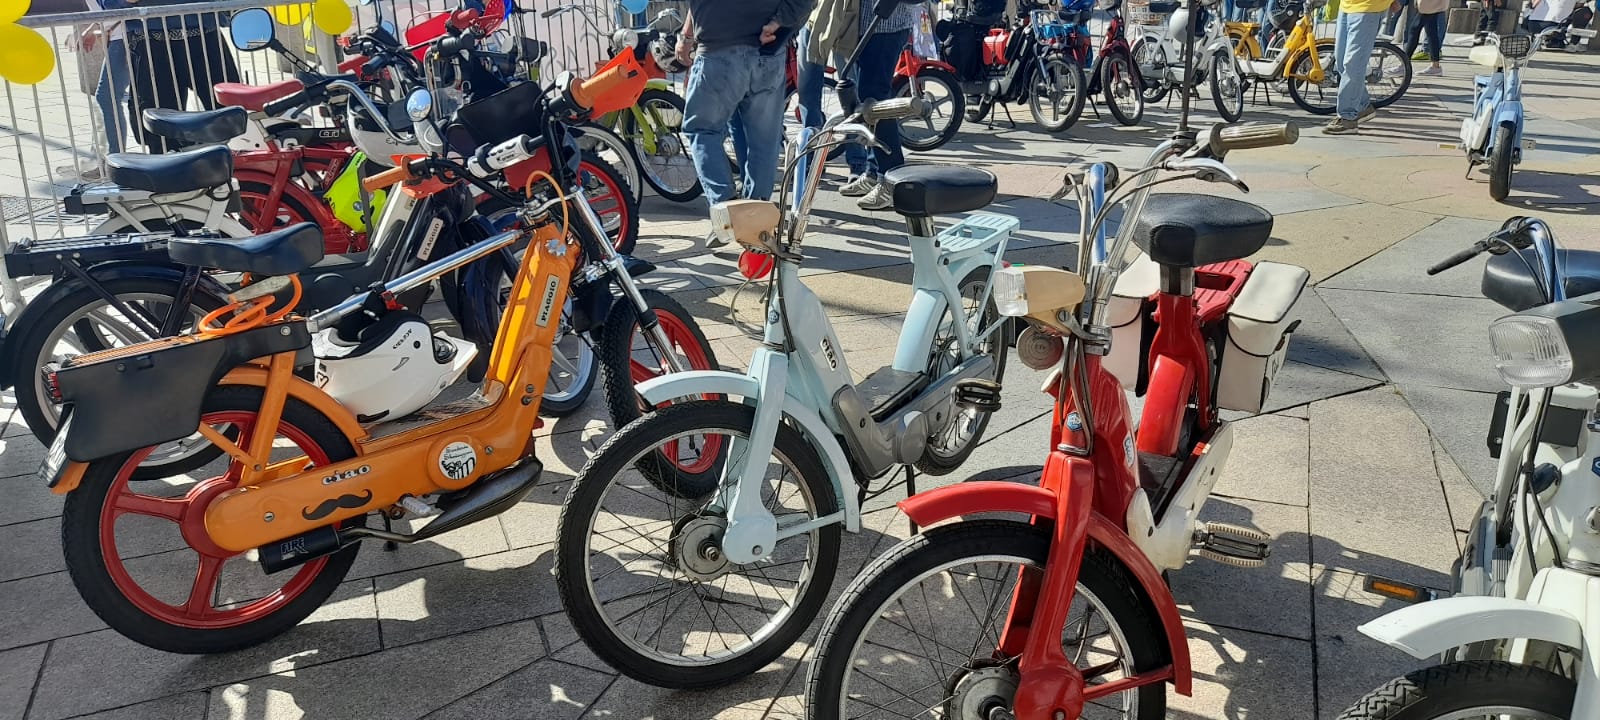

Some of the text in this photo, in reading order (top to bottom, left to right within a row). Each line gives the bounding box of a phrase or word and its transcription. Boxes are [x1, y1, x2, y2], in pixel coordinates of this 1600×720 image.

[423, 223, 440, 256] PIAGGIO
[541, 281, 557, 321] PIAGGIO
[821, 337, 838, 370] ciao
[322, 465, 370, 485] ciao
[280, 536, 309, 556] FIRE
